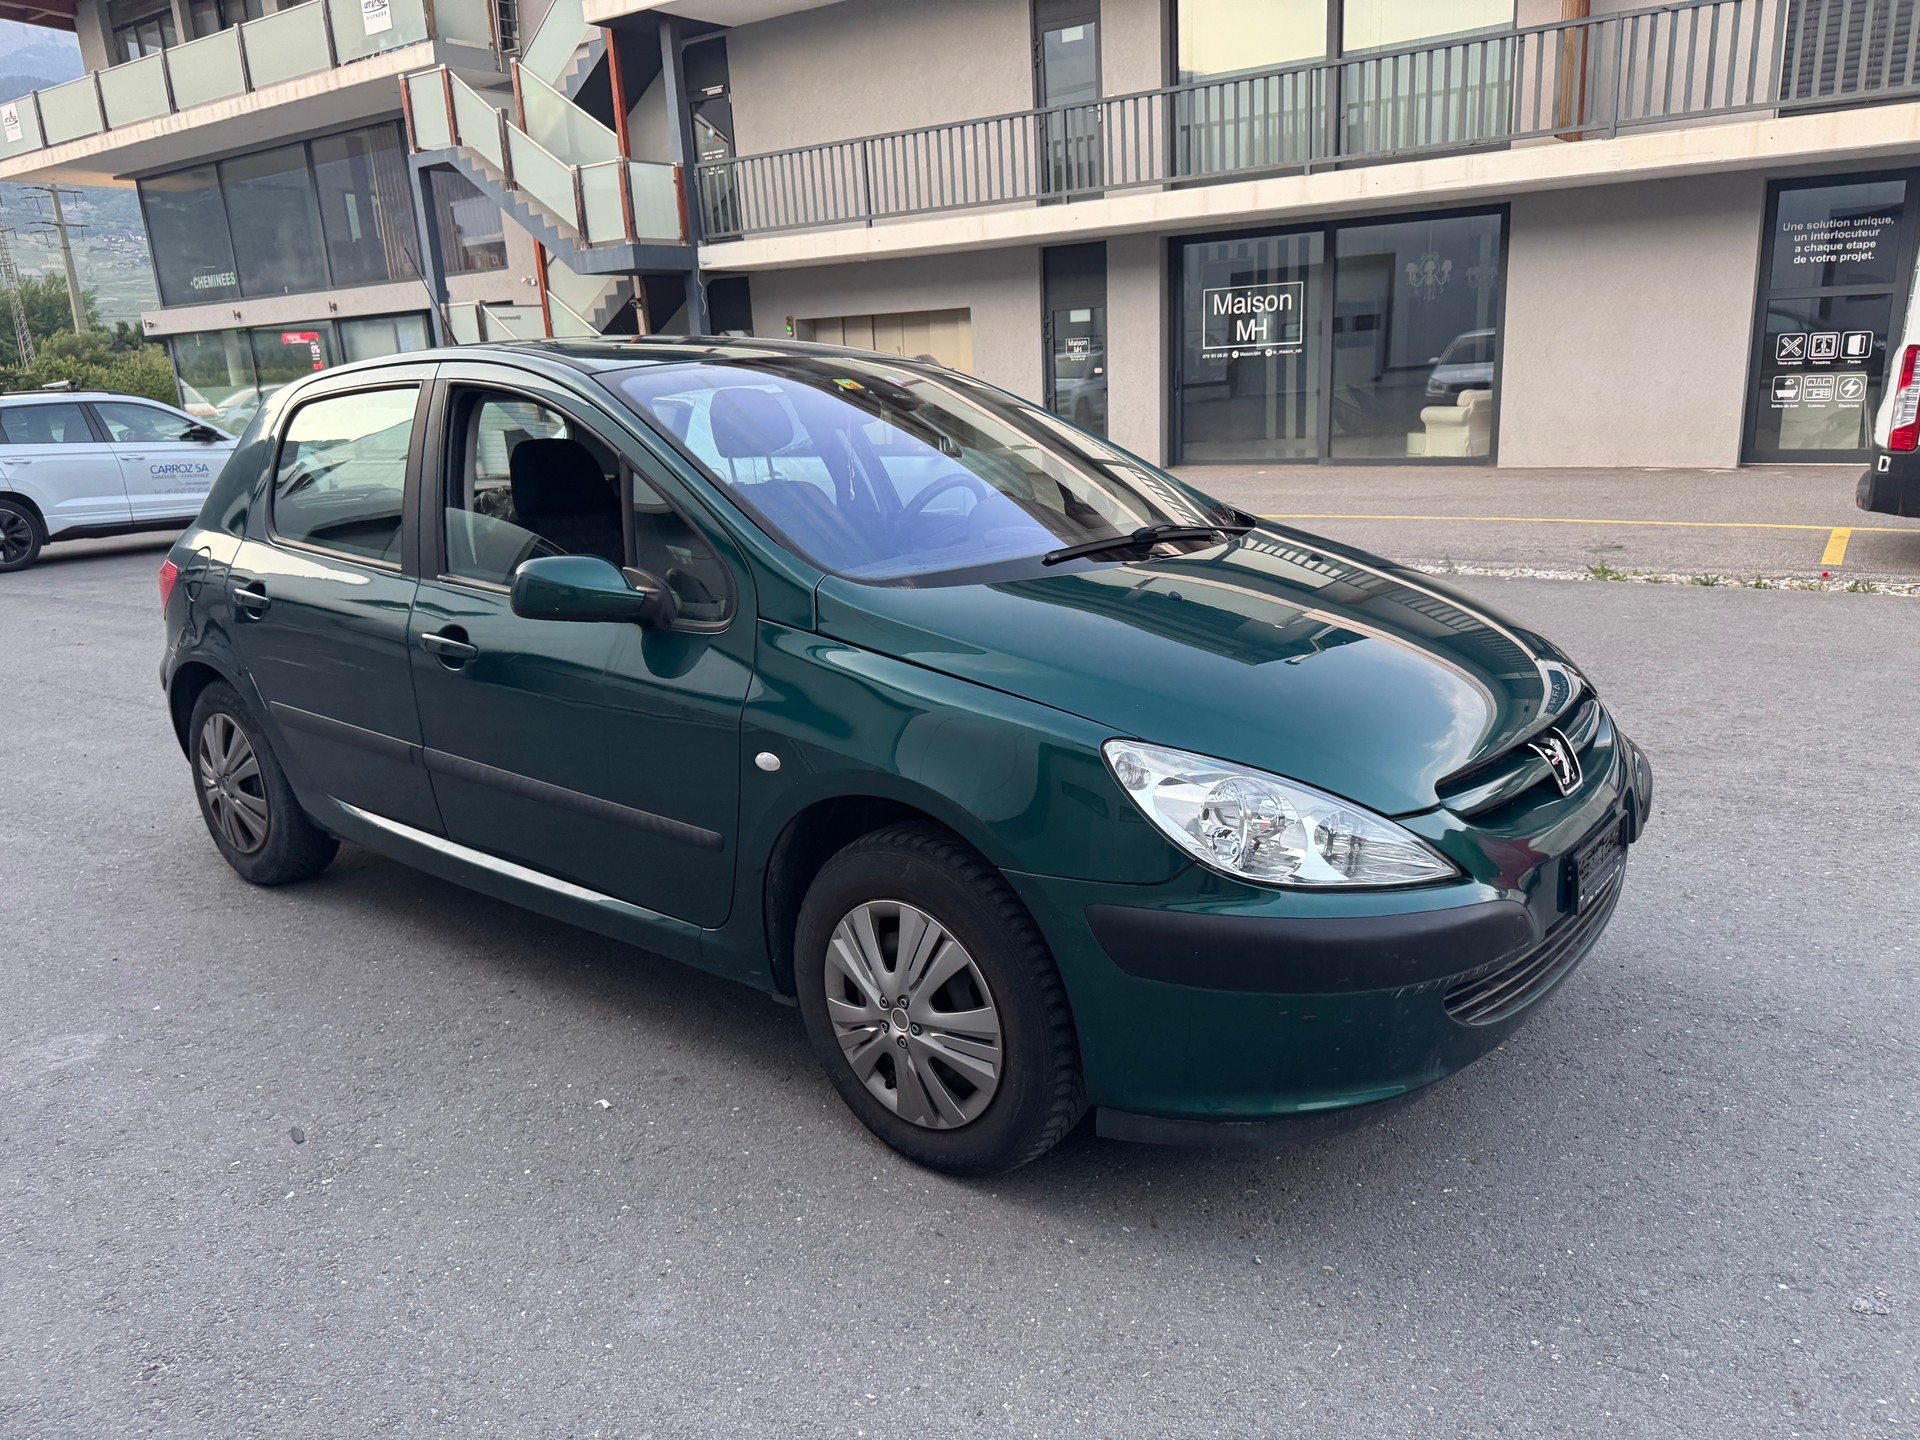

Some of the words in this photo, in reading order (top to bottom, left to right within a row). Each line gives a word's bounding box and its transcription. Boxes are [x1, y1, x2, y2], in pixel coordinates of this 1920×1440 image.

[1783, 222, 1803, 231] Une
[1806, 219, 1850, 230] solution
[1853, 216, 1895, 227] unique,
[1794, 234, 1807, 242] un
[1810, 229, 1880, 241] interlocuteur
[1804, 242, 1843, 253] chaque
[1846, 240, 1877, 251] etape
[1793, 255, 1807, 264] de
[1809, 253, 1837, 263] votre
[1839, 251, 1875, 263] projet.
[193, 271, 236, 290] CHEMINEES
[1213, 291, 1292, 316] Maison
[1236, 318, 1268, 342] MH
[150, 464, 193, 474] CARROZ
[195, 463, 209, 473] SA
